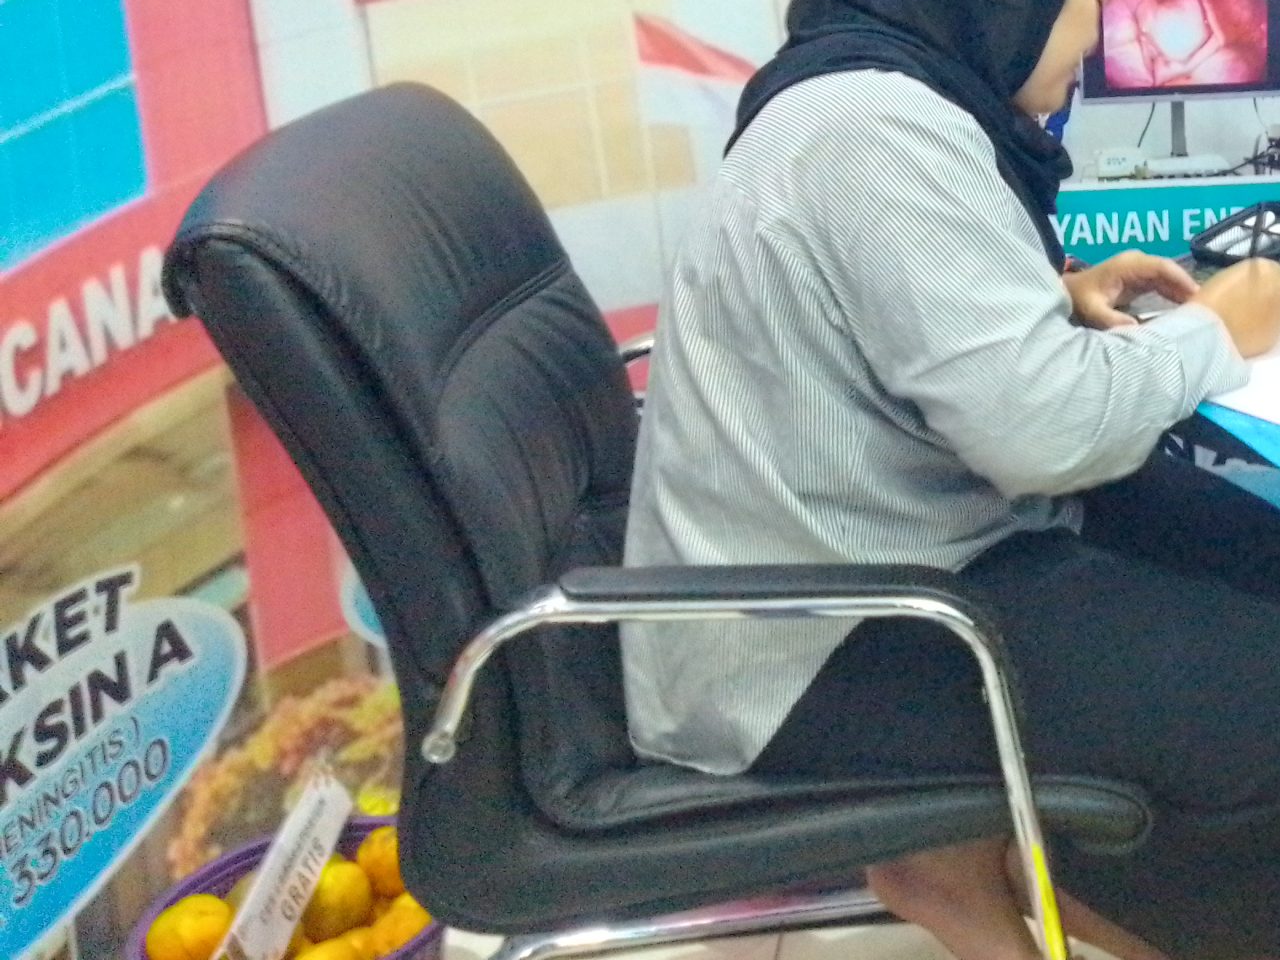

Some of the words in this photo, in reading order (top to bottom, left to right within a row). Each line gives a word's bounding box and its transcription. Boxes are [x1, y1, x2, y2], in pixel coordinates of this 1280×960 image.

[0, 570, 133, 702] KET
[147, 618, 193, 685] A
[0, 726, 124, 855] ENINGITIS
[13, 738, 169, 905] 330.000
[280, 837, 325, 922] GRATIS
